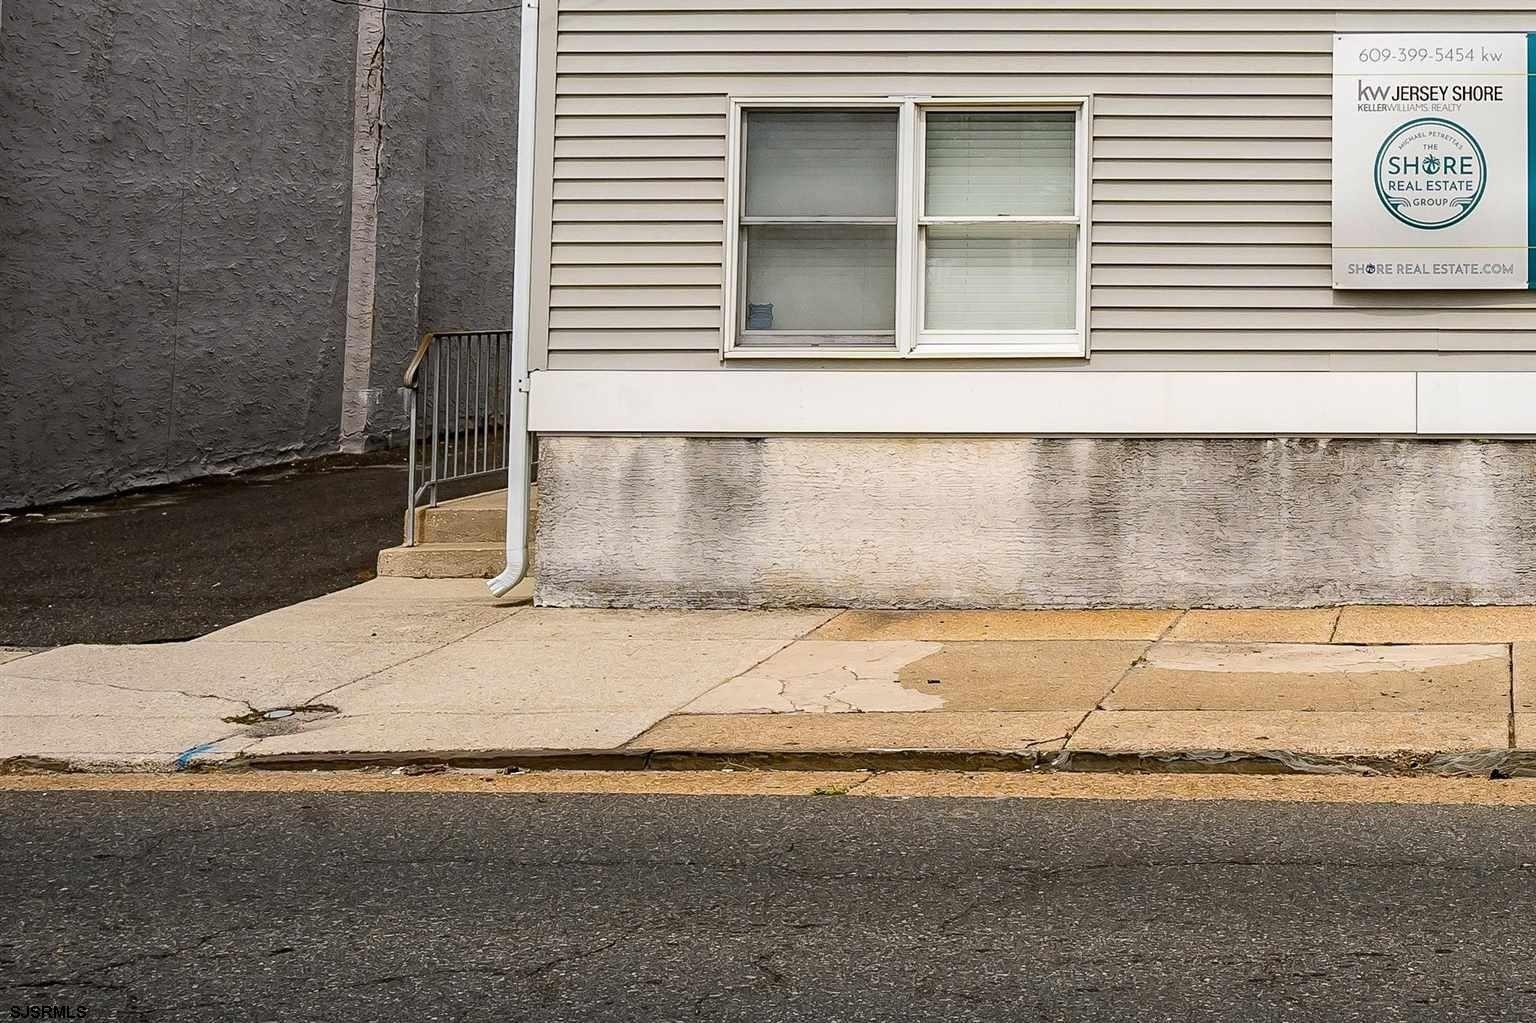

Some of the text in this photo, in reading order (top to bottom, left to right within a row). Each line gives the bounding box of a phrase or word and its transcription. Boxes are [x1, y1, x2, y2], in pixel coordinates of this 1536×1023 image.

[1359, 46, 1503, 63] 609-399-5454 kw
[1358, 79, 1503, 101] kw JERSEY SHORE
[1431, 103, 1462, 112] REALTY
[1398, 132, 1426, 150] MICHAEL
[1388, 154, 1473, 175] SHORE
[1388, 180, 1473, 191] REAL ESTATE
[1412, 198, 1448, 206] GROUP
[1348, 263, 1514, 275] SHORE REAL ESTATE.COM
